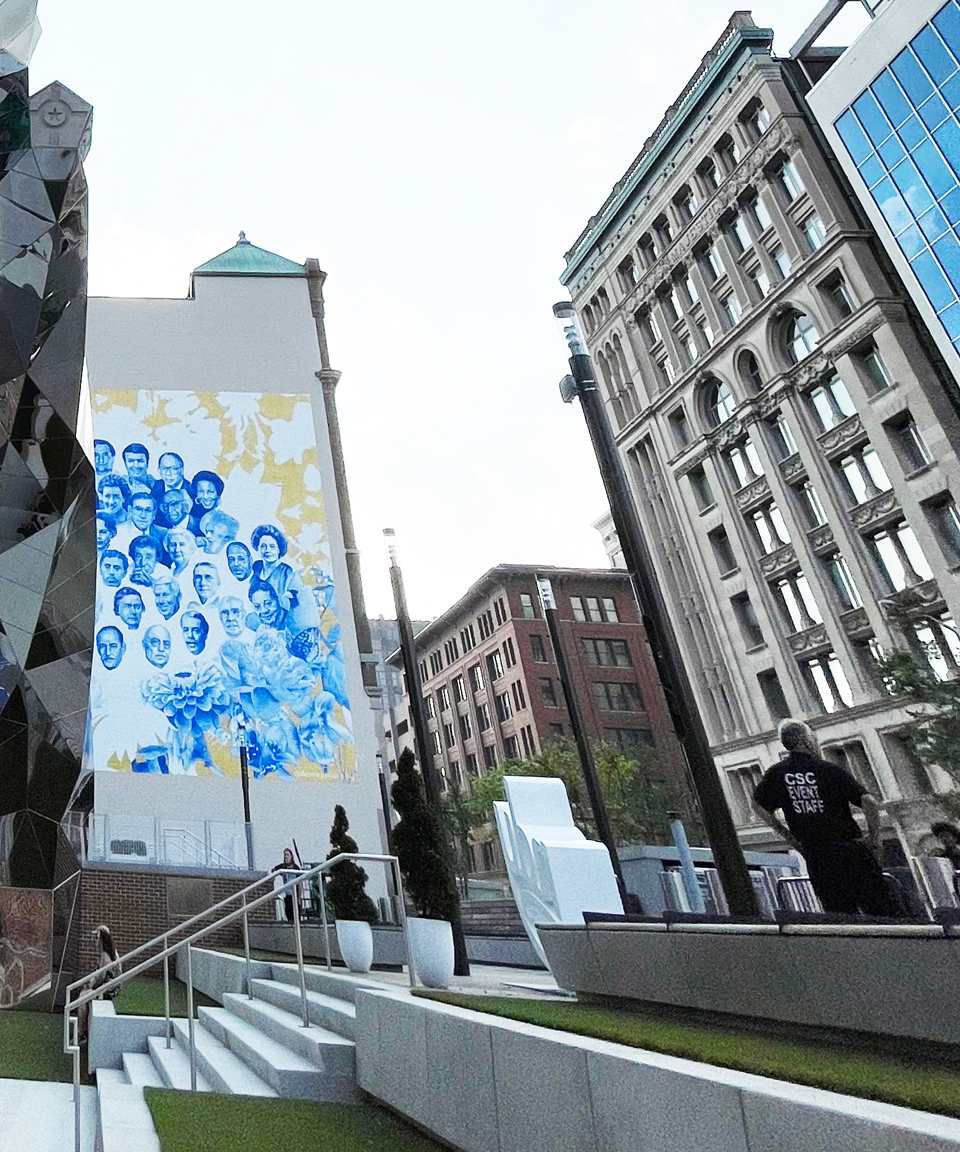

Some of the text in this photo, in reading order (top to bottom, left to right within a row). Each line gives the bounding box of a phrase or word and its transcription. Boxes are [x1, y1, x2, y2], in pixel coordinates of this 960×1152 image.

[670, 201, 721, 263] MAJESTIC
[785, 772, 816, 785] CSC
[788, 785, 820, 800] EVENT
[793, 800, 824, 813] STAFF
